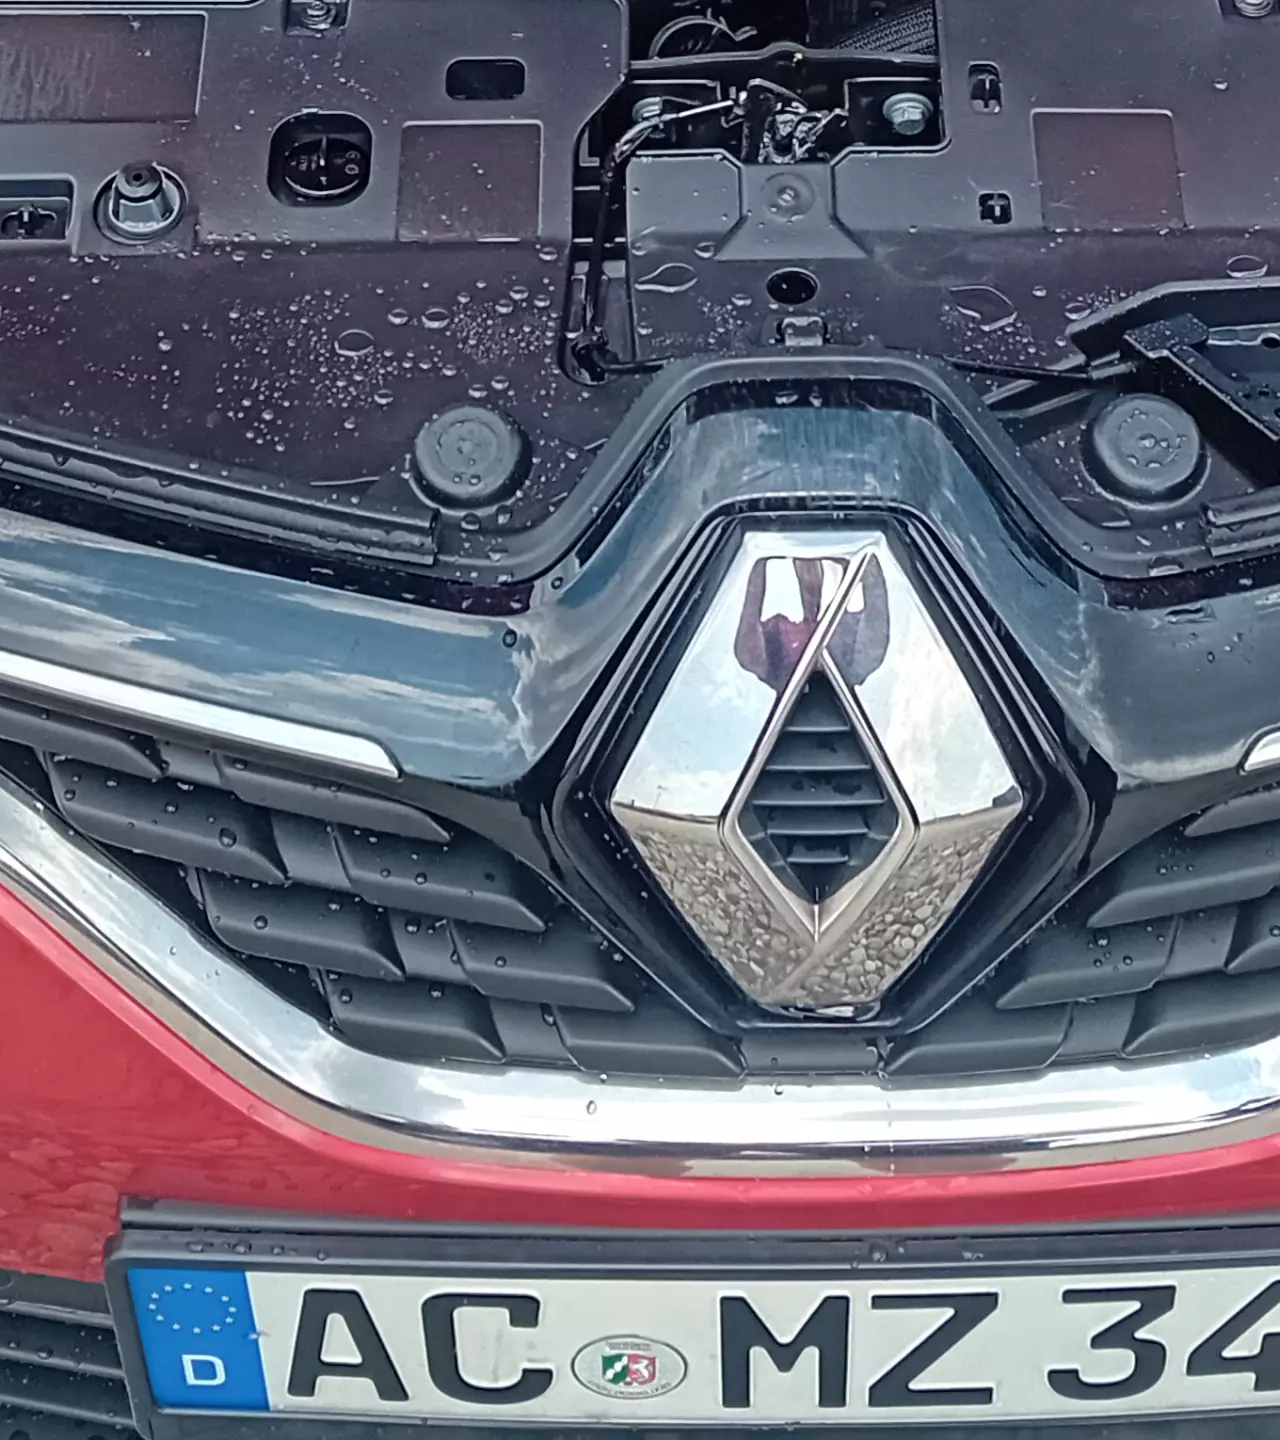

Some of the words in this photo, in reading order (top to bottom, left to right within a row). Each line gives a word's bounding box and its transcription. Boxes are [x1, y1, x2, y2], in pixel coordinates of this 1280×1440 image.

[181, 1353, 227, 1387] D
[287, 1287, 554, 1406] AC
[719, 1291, 1000, 1408] MZ
